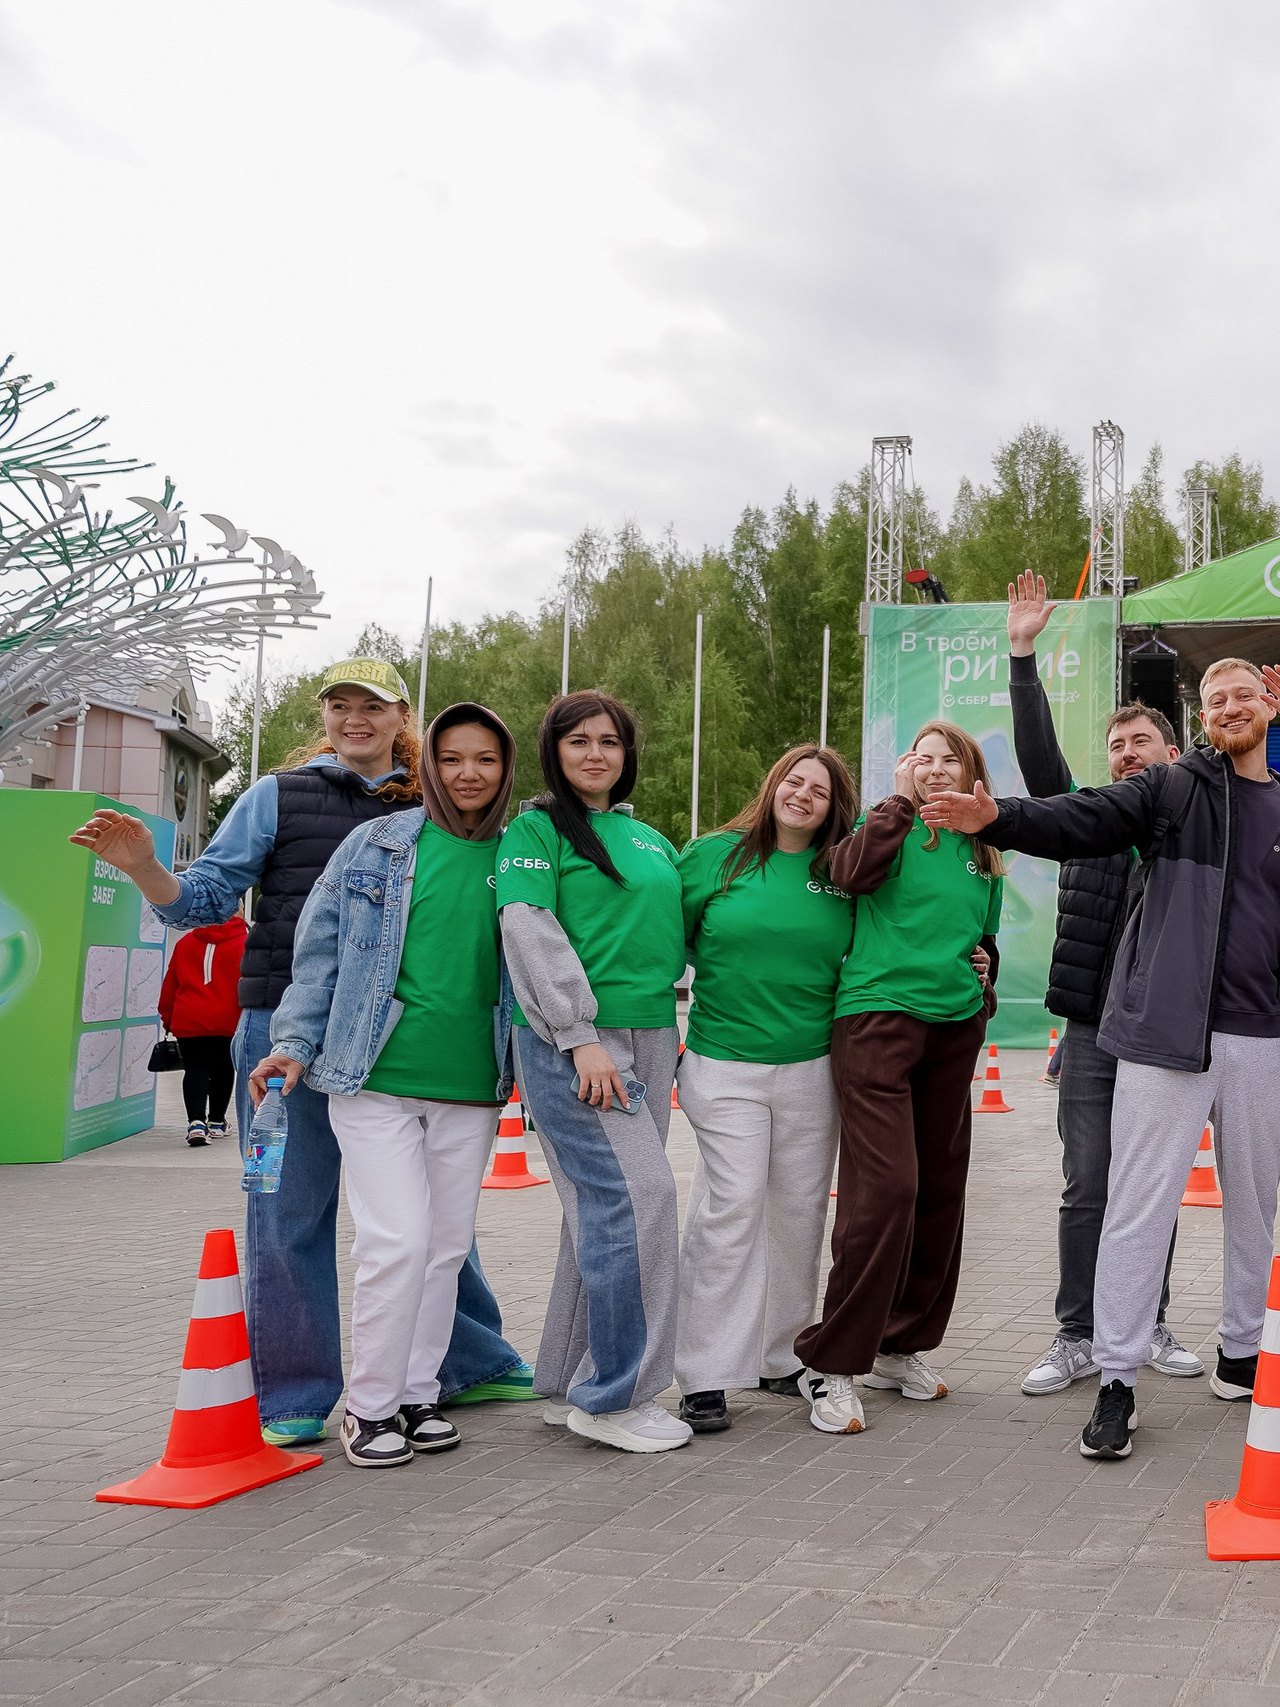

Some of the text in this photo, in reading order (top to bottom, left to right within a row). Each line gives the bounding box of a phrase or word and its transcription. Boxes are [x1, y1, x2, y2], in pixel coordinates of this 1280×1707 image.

[901, 630, 997, 652] В твоём
[331, 664, 387, 685] RUSSIA
[958, 695, 989, 706] СБЕР
[92, 885, 116, 906] ЗАБЕГ
